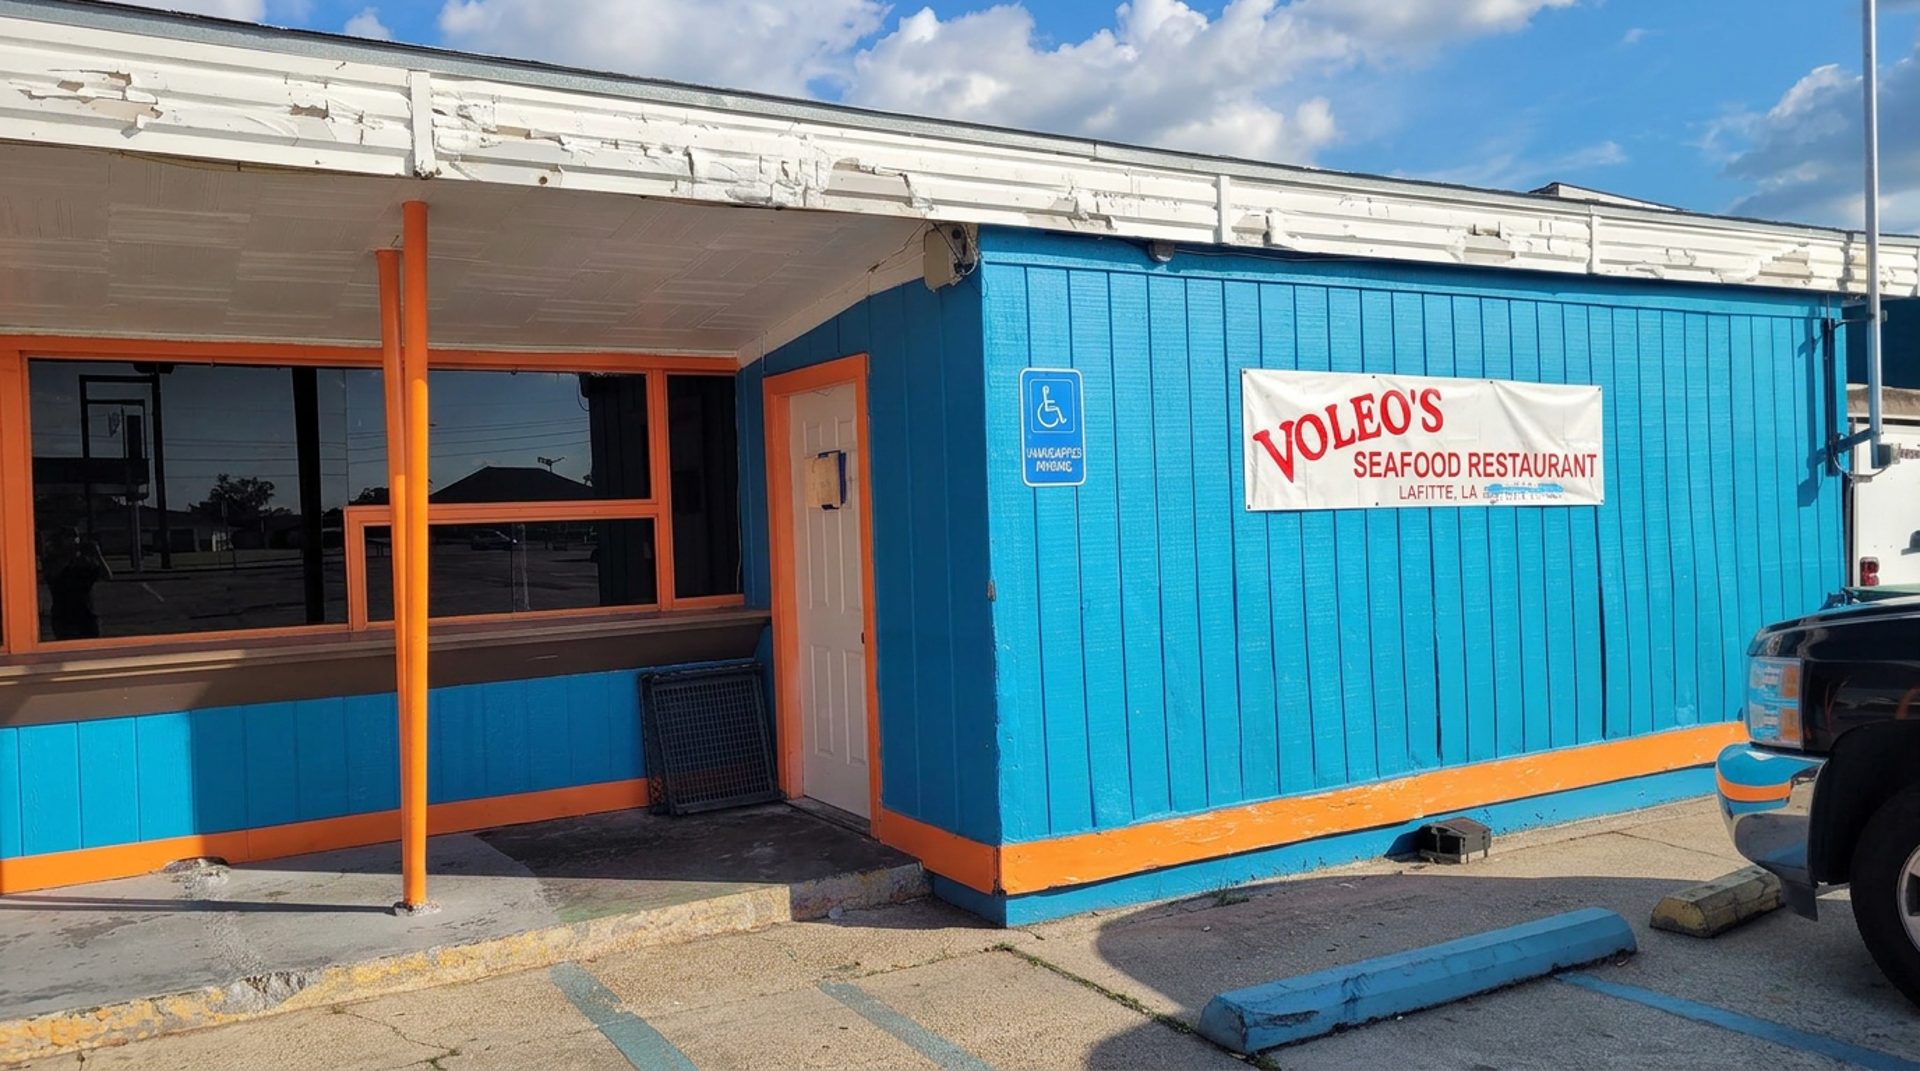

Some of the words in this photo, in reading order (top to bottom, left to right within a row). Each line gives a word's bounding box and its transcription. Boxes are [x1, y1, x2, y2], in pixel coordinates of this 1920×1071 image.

[1253, 388, 1444, 483] VOLEO'S
[1353, 451, 1461, 479] SEAFOOD
[1468, 452, 1597, 478] RESTAURANT
[1399, 484, 1458, 500] LAFITTE,
[1461, 484, 1478, 499] LA
